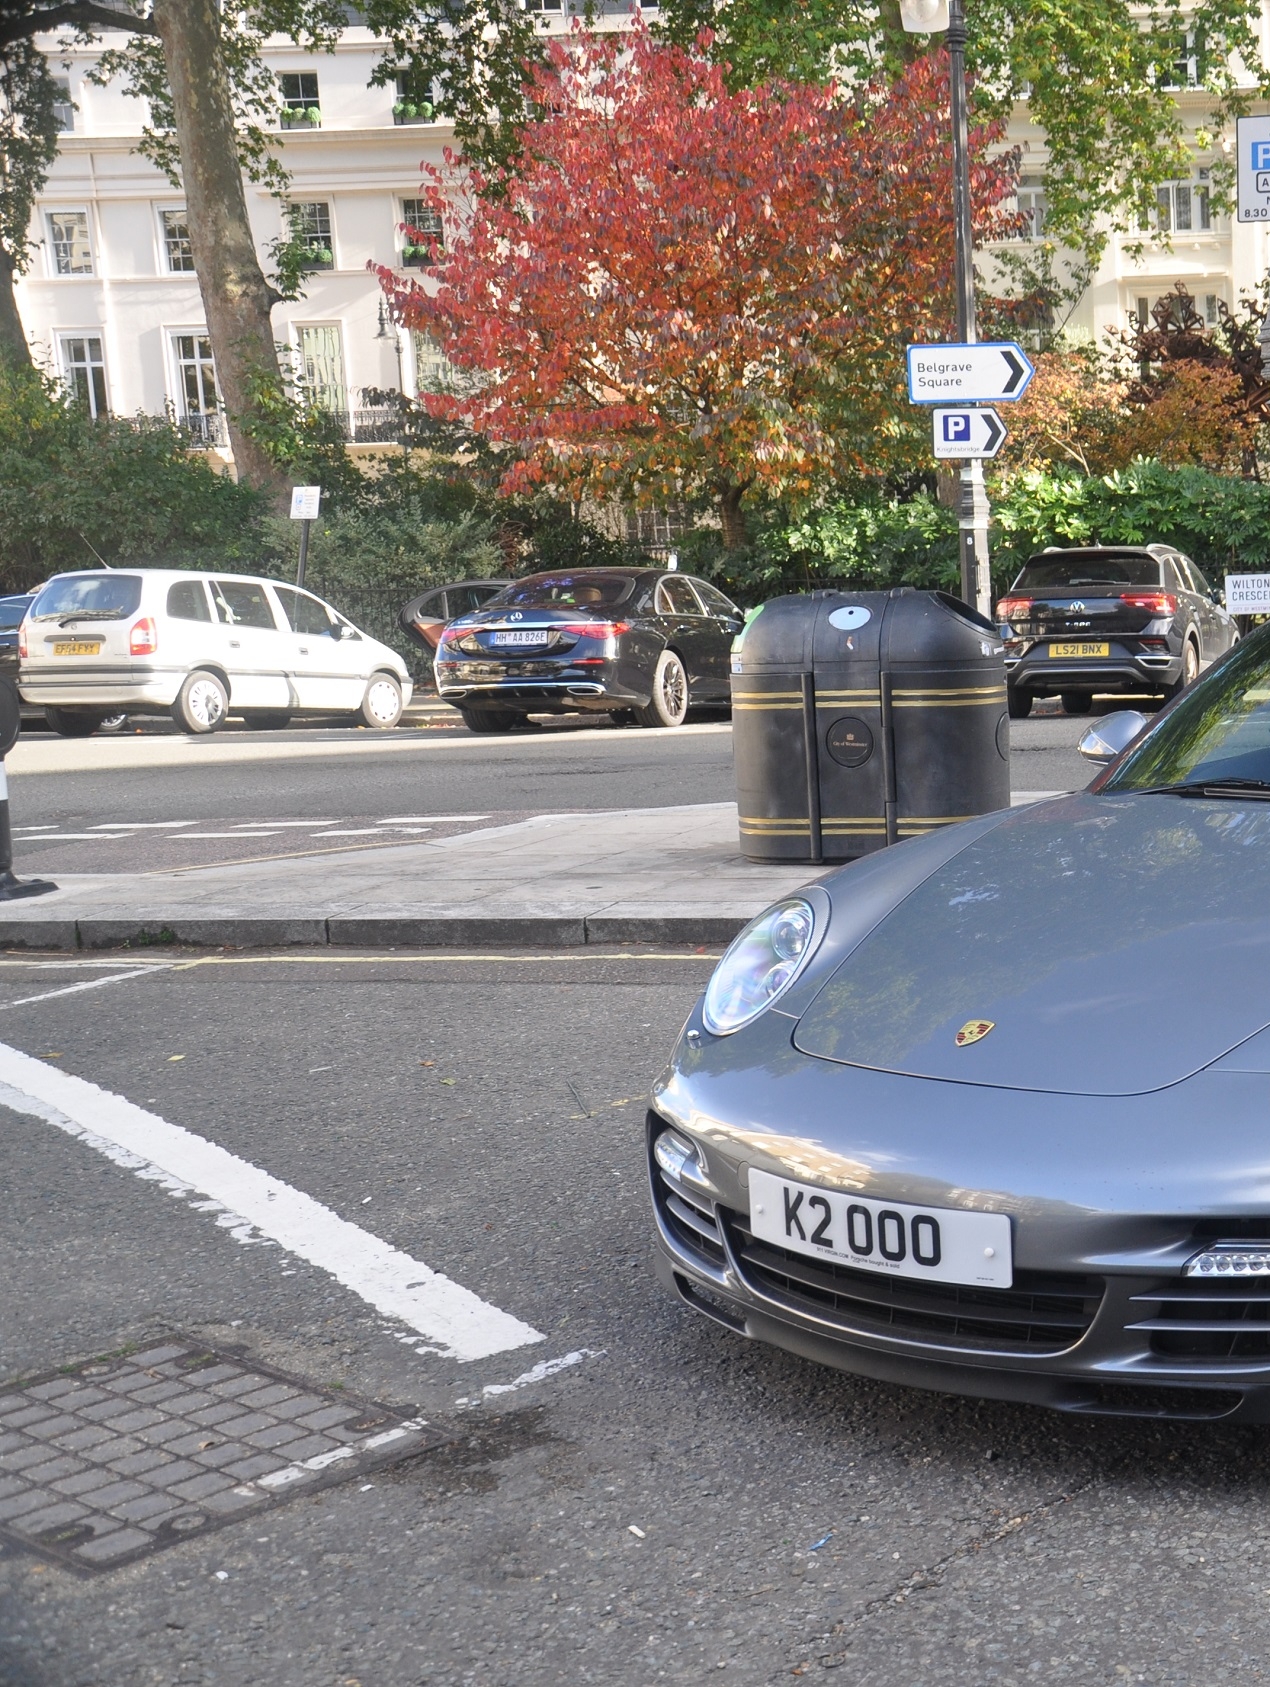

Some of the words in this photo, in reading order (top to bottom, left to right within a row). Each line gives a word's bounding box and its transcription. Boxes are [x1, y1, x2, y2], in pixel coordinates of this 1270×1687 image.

[1262, 178, 1269, 187] A
[1244, 208, 1268, 218] 8.30
[917, 362, 972, 374] Belgrave
[918, 377, 962, 388] Square
[948, 416, 965, 440] P
[1232, 579, 1270, 589] WILTON
[496, 633, 507, 643] HH
[512, 632, 523, 642] AA
[525, 632, 546, 642] 826E
[1056, 644, 1079, 655] LS21
[1081, 644, 1102, 655] BNX
[783, 1186, 834, 1249] K2
